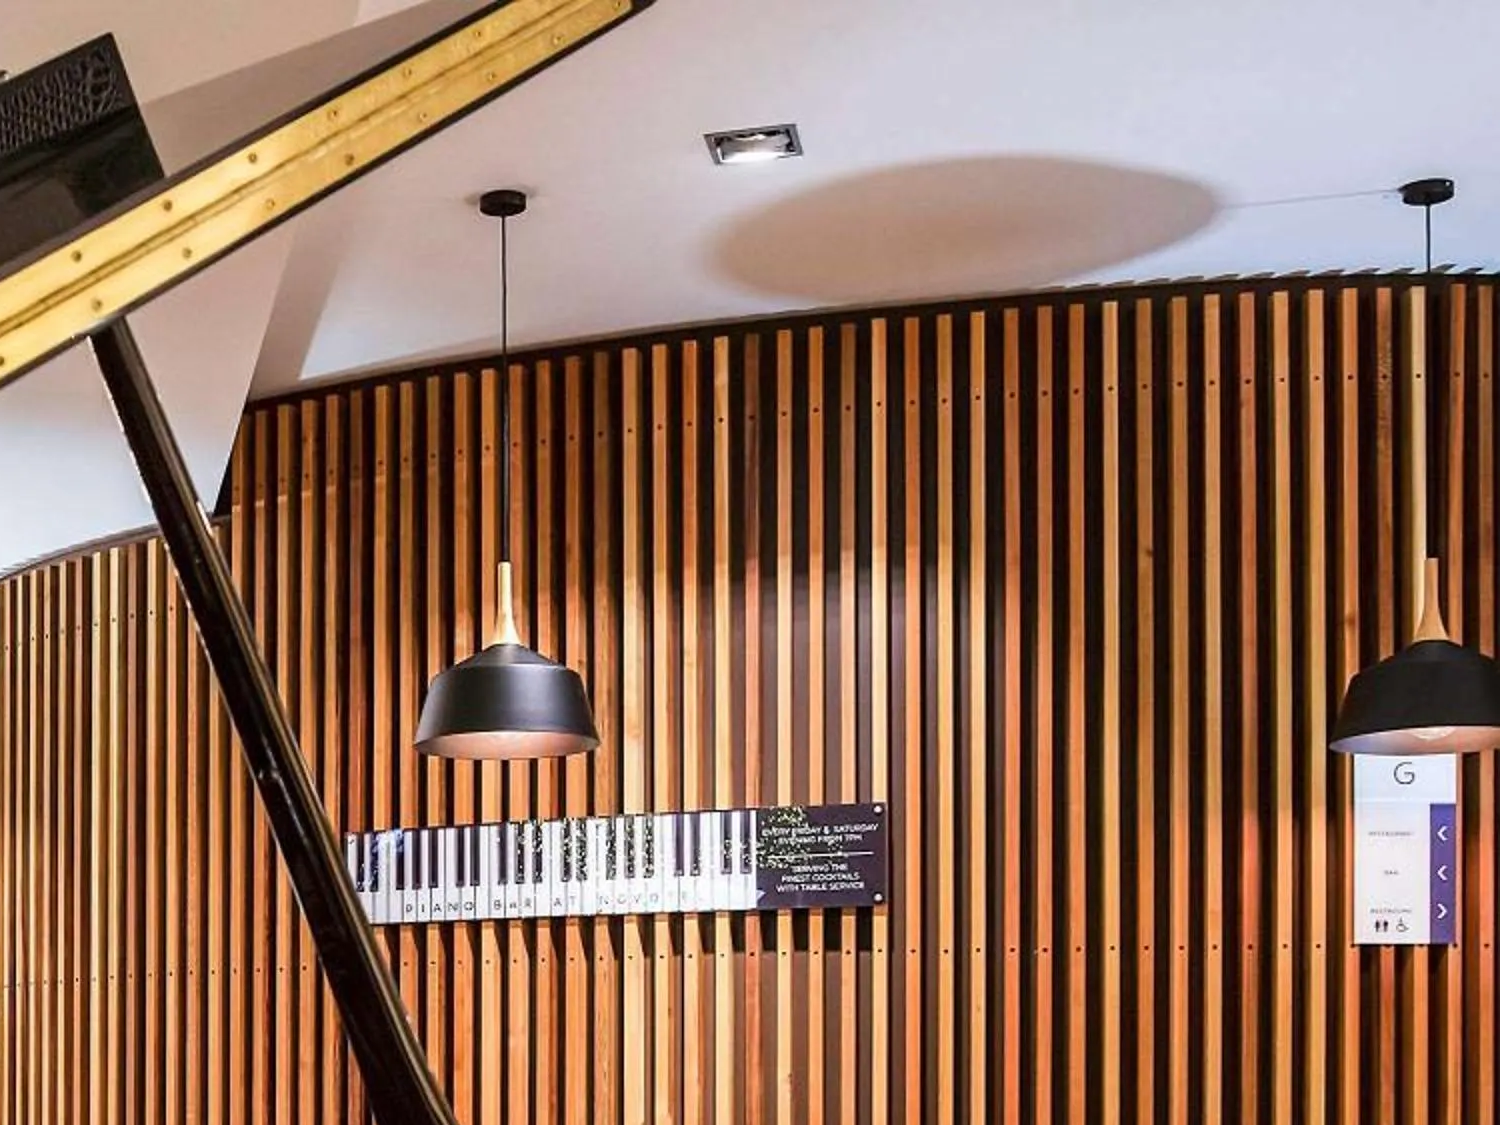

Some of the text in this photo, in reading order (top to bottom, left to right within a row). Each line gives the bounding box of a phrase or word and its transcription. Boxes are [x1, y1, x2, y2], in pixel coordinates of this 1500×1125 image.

[1393, 761, 1416, 785] G
[833, 823, 879, 833] SATURDAY
[812, 872, 860, 882] COCKTAILS
[775, 882, 865, 893] WITH TABLE SERVICE
[405, 900, 475, 914] PIANO
[553, 894, 578, 907] AT
